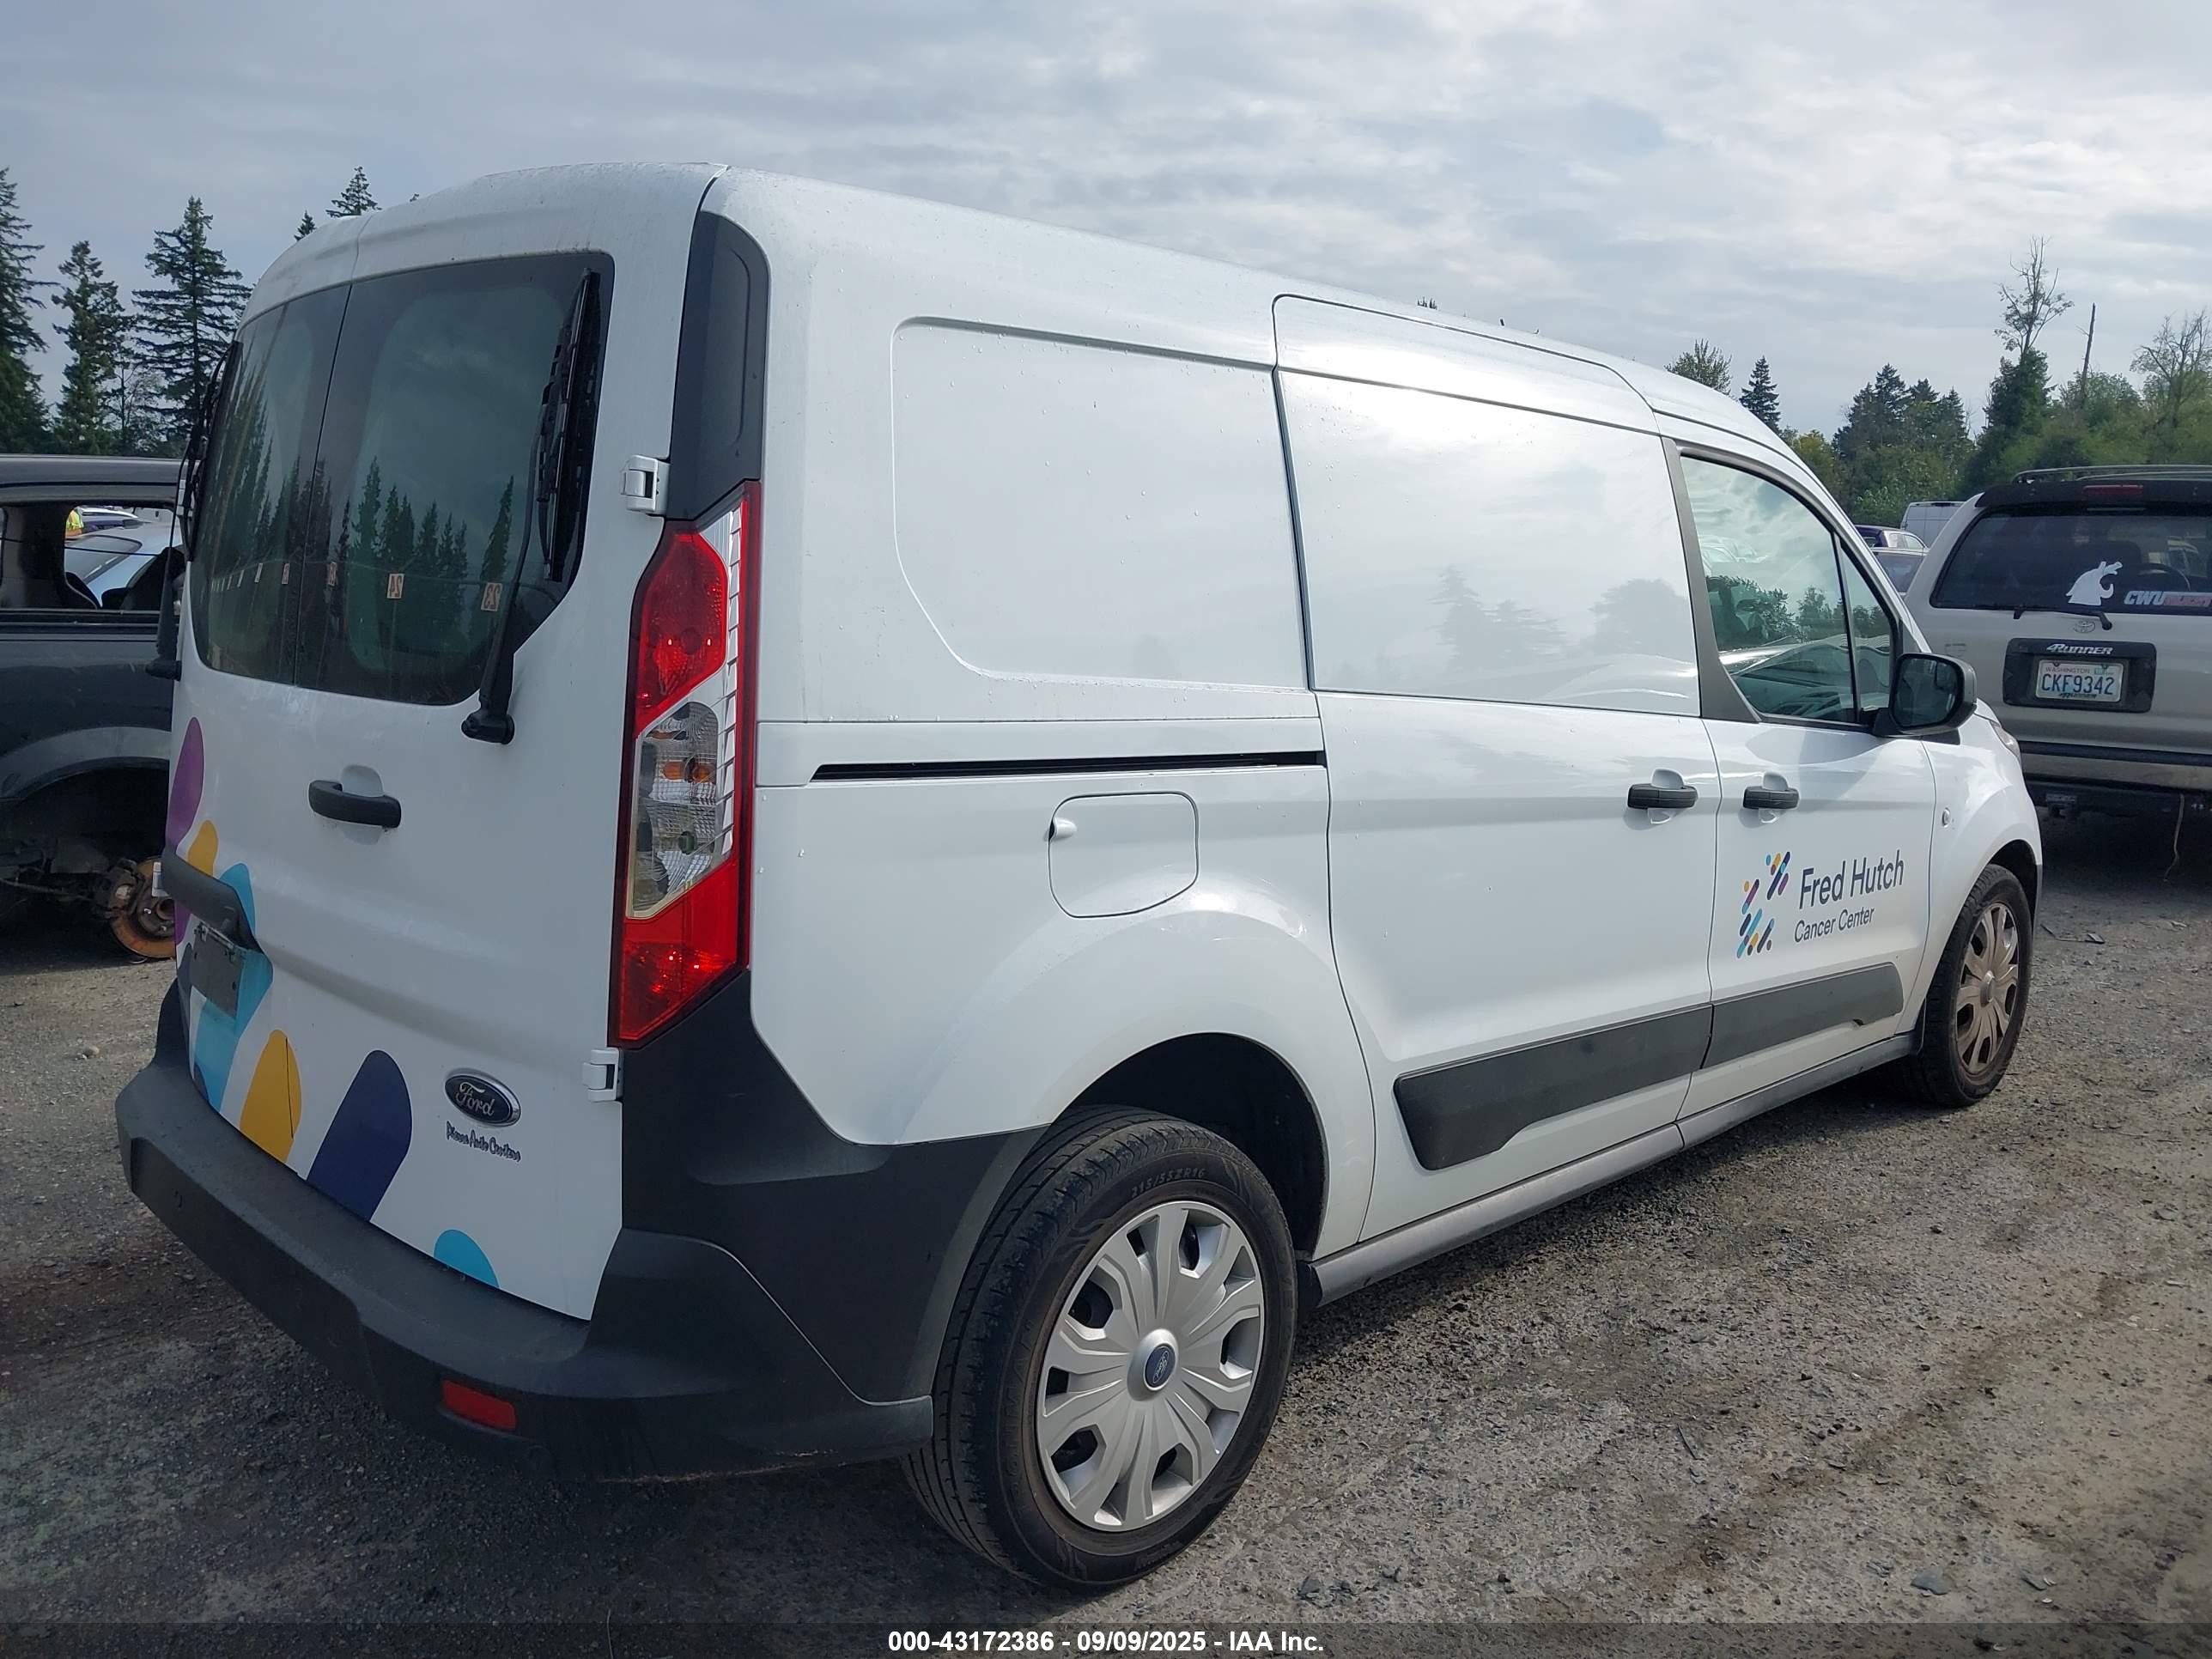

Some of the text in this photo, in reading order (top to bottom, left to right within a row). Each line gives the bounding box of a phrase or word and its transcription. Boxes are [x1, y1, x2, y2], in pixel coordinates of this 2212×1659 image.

[2124, 591, 2164, 605] CWU
[2045, 665, 2090, 674] WASHINGTON
[2041, 673, 2115, 696] CKF9342
[1799, 849, 1905, 909] Fred Hutch
[1794, 906, 1875, 943] Cancer Center
[455, 1081, 495, 1117] Ford
